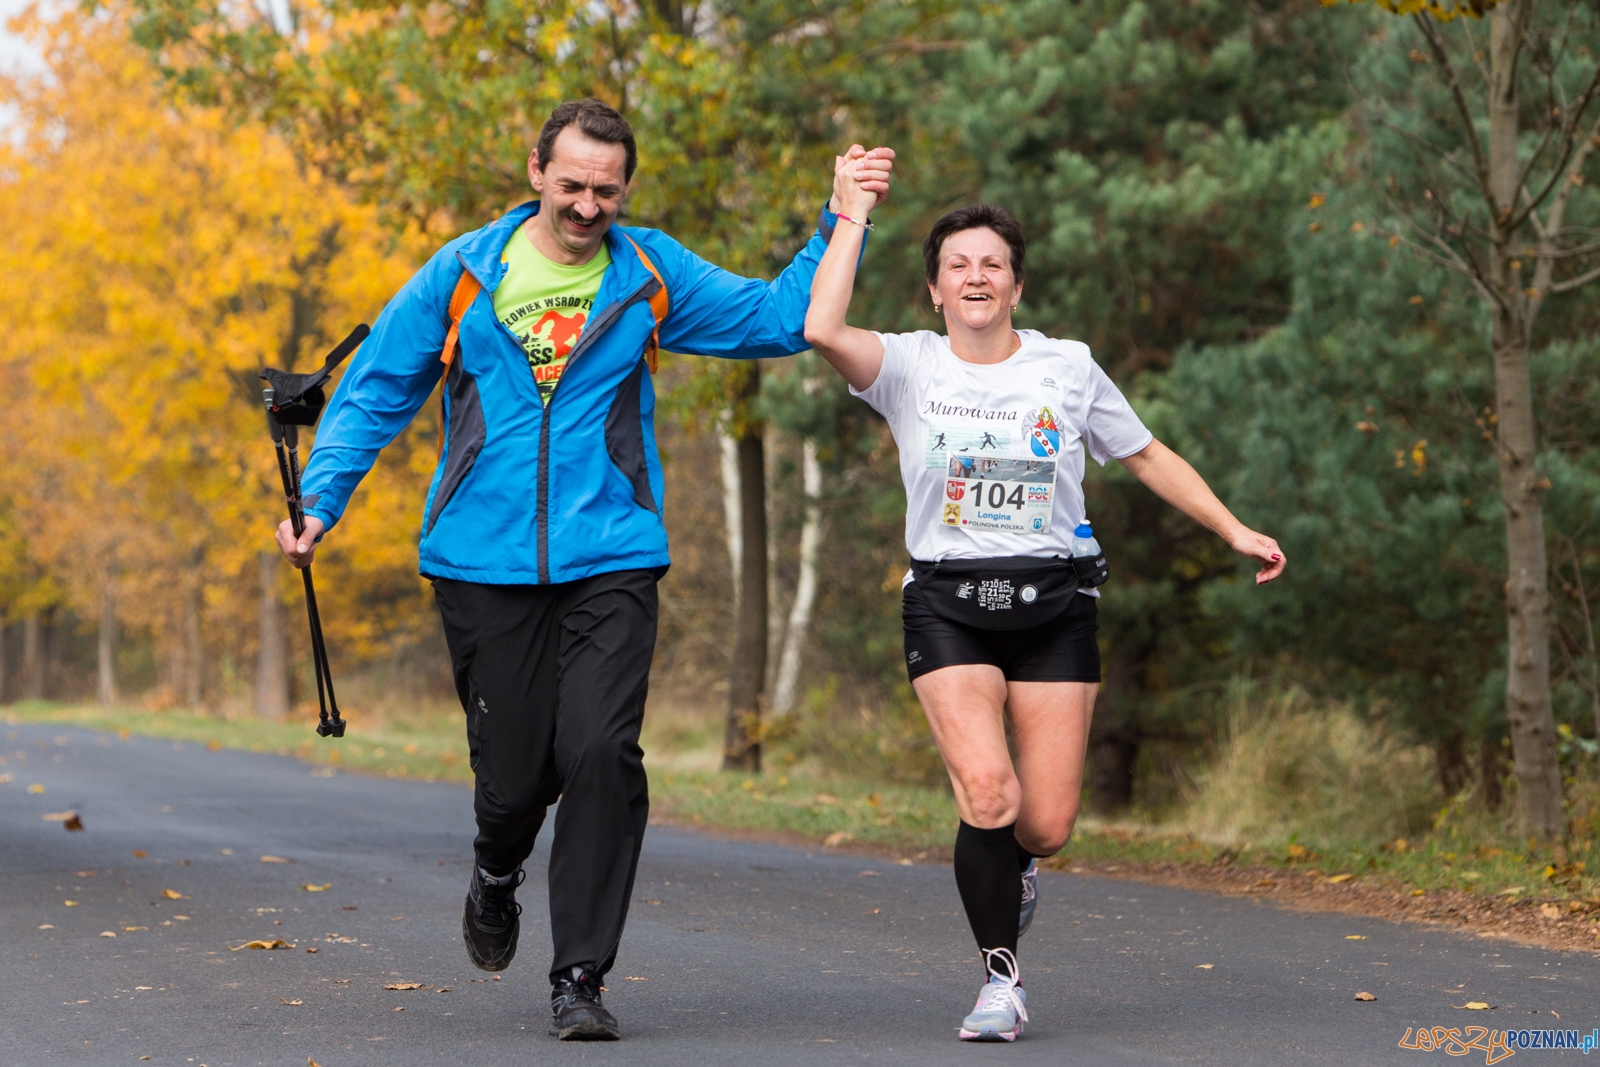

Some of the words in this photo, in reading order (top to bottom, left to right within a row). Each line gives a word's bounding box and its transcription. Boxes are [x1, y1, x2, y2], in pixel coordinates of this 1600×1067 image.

[544, 295, 581, 308] WŚRÓD
[526, 347, 553, 366] SS
[923, 400, 1018, 421] Murowana
[970, 481, 1025, 510] 104
[977, 511, 1011, 521] Longina
[968, 520, 999, 529] POLINOVA
[1000, 522, 1025, 531] POLSKA
[987, 588, 998, 597] 21
